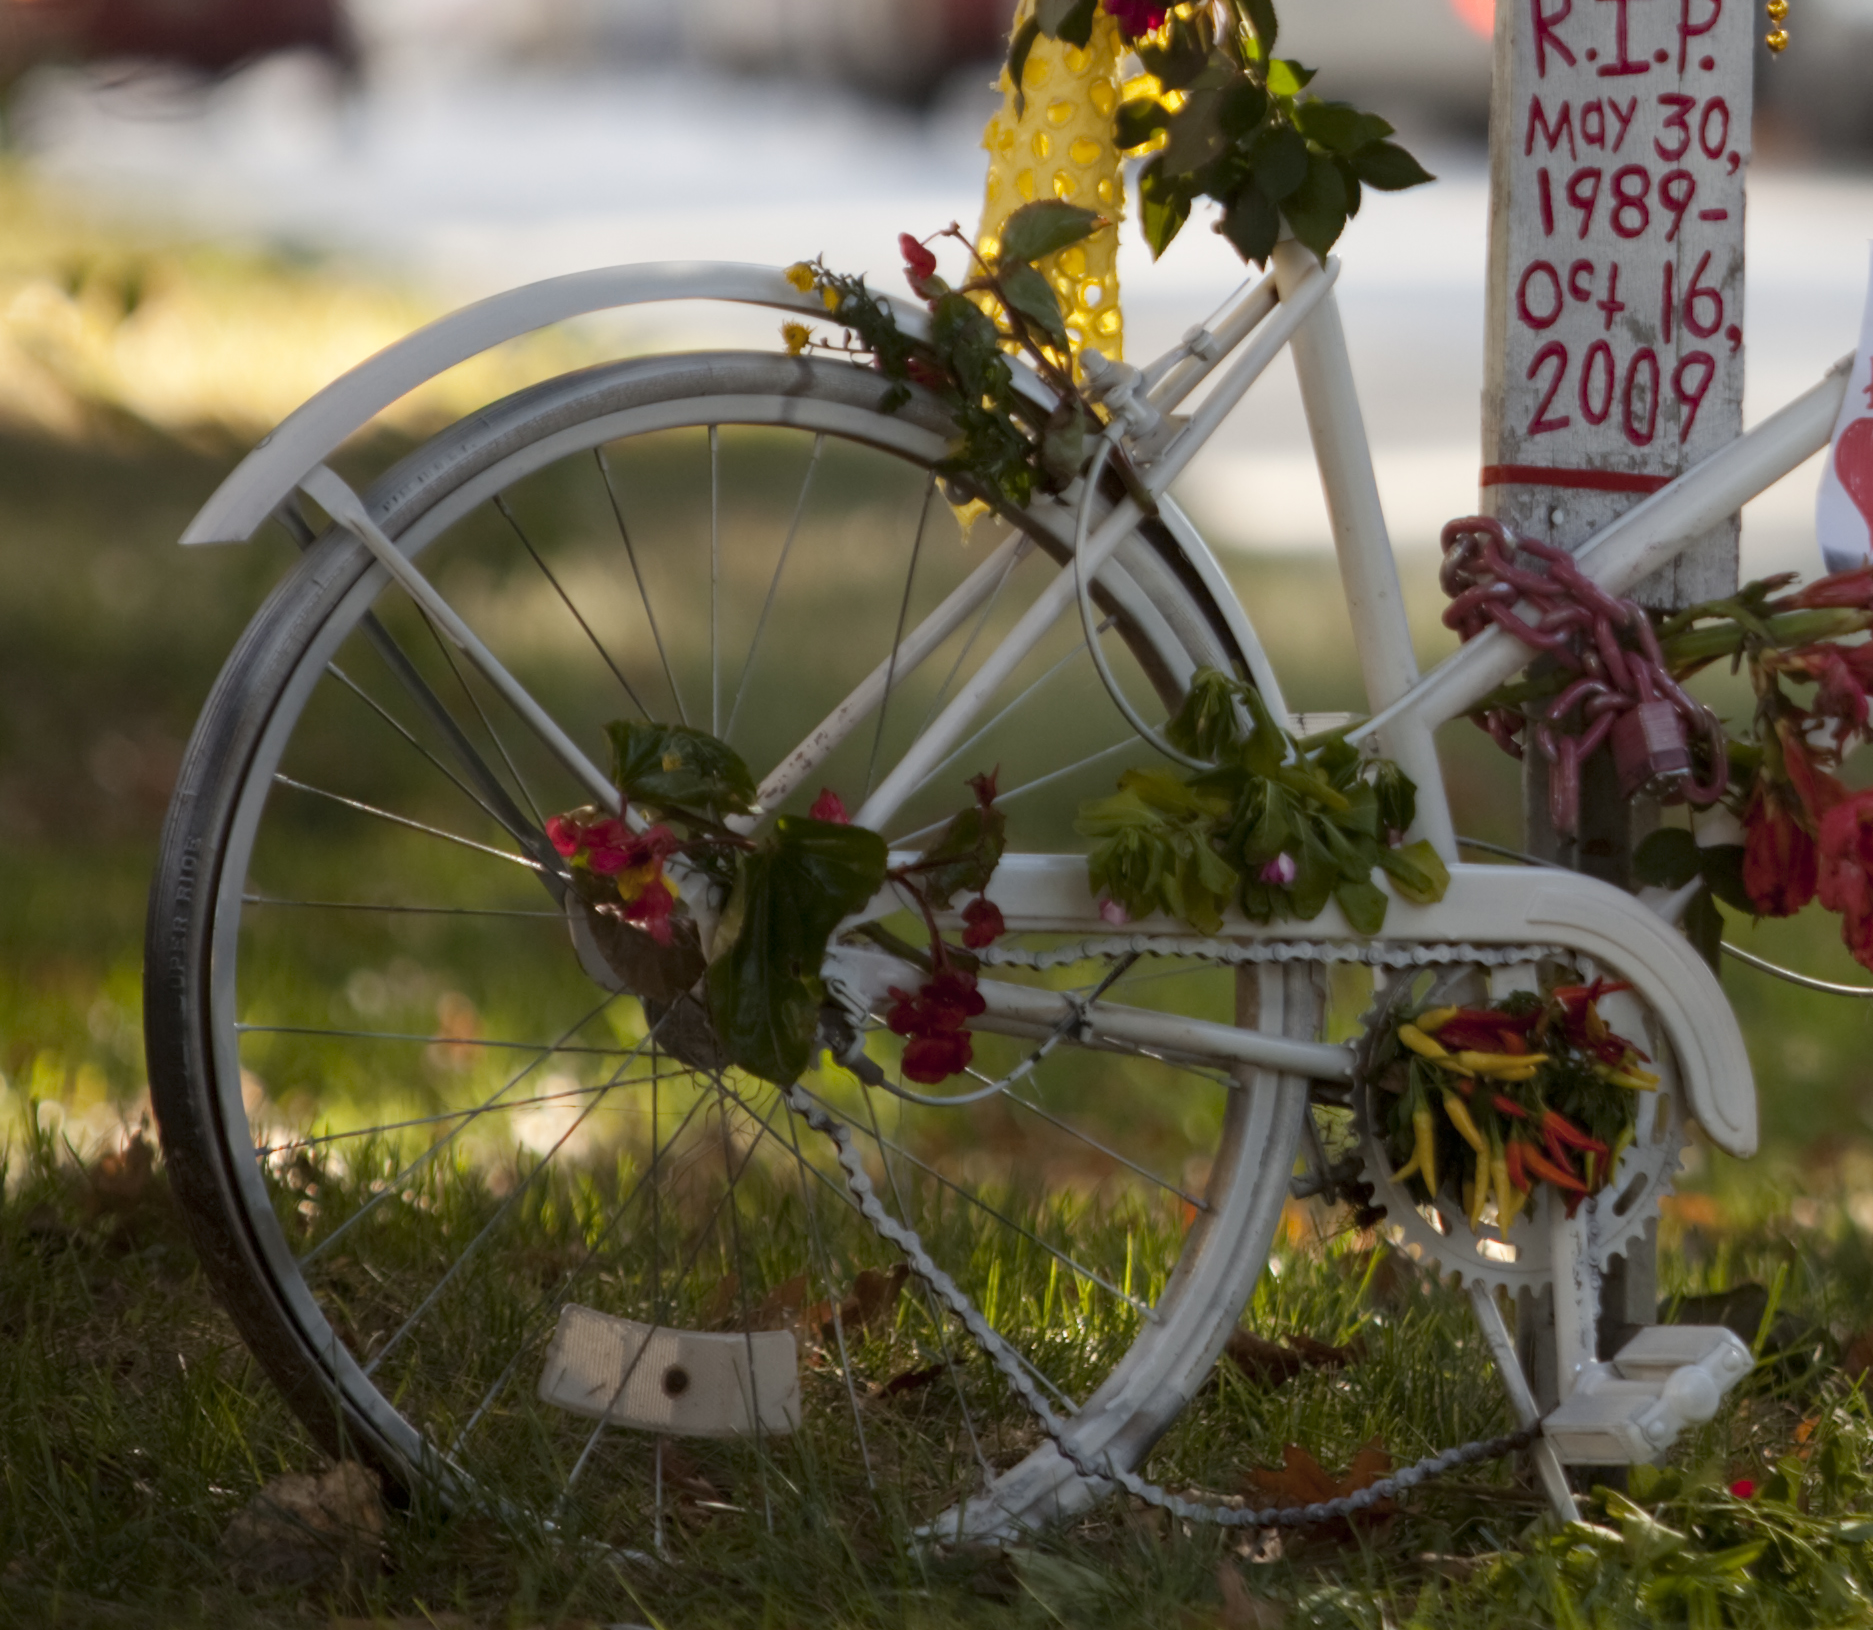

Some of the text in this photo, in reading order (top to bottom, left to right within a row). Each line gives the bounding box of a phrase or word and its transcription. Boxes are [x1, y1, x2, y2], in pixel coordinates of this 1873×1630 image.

[1654, 93, 1741, 175] 30,
[1537, 164, 1728, 242] 1989-
[1661, 250, 1743, 352] 16,
[1526, 340, 1715, 446] 2009
[169, 916, 191, 1013] UPER
